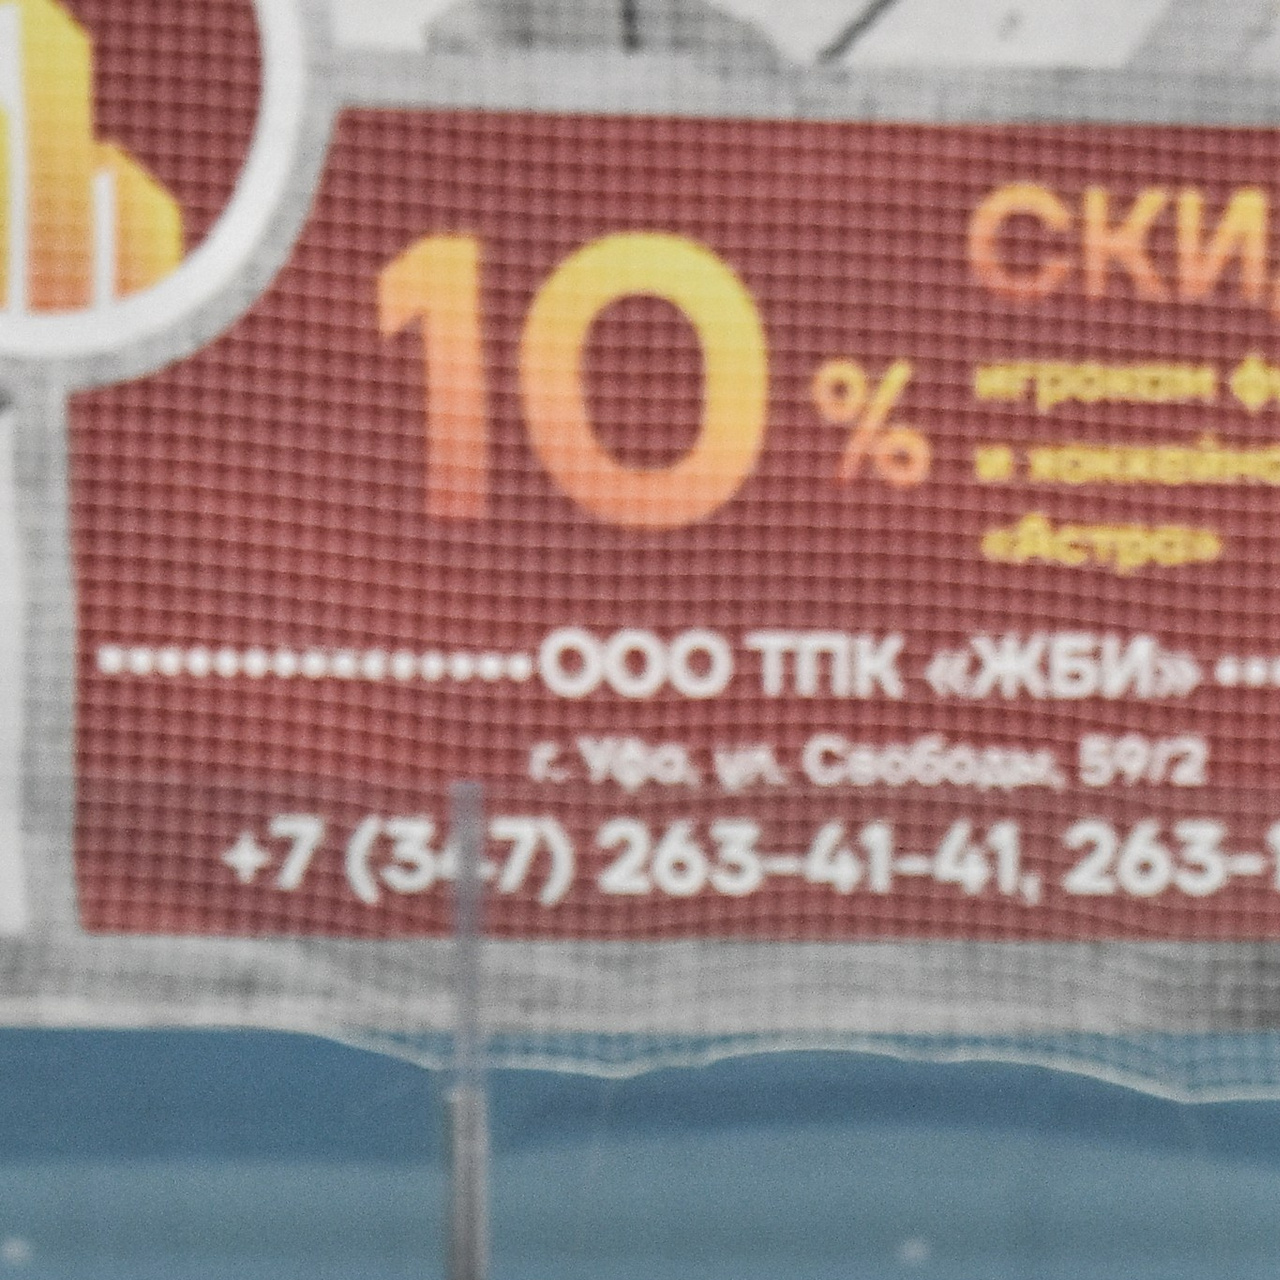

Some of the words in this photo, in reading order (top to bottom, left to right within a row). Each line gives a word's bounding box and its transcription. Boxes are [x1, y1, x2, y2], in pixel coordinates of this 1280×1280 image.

[378, 231, 769, 530] 10
[812, 360, 932, 487] %
[980, 510, 1223, 577] «Астра»
[539, 627, 735, 699] ООО
[743, 630, 904, 697] ТПК
[924, 630, 1201, 700] «ЖБИ»
[1078, 732, 1207, 787] 59/2
[221, 812, 325, 892] +7
[598, 817, 1041, 905] 263-41-41,
